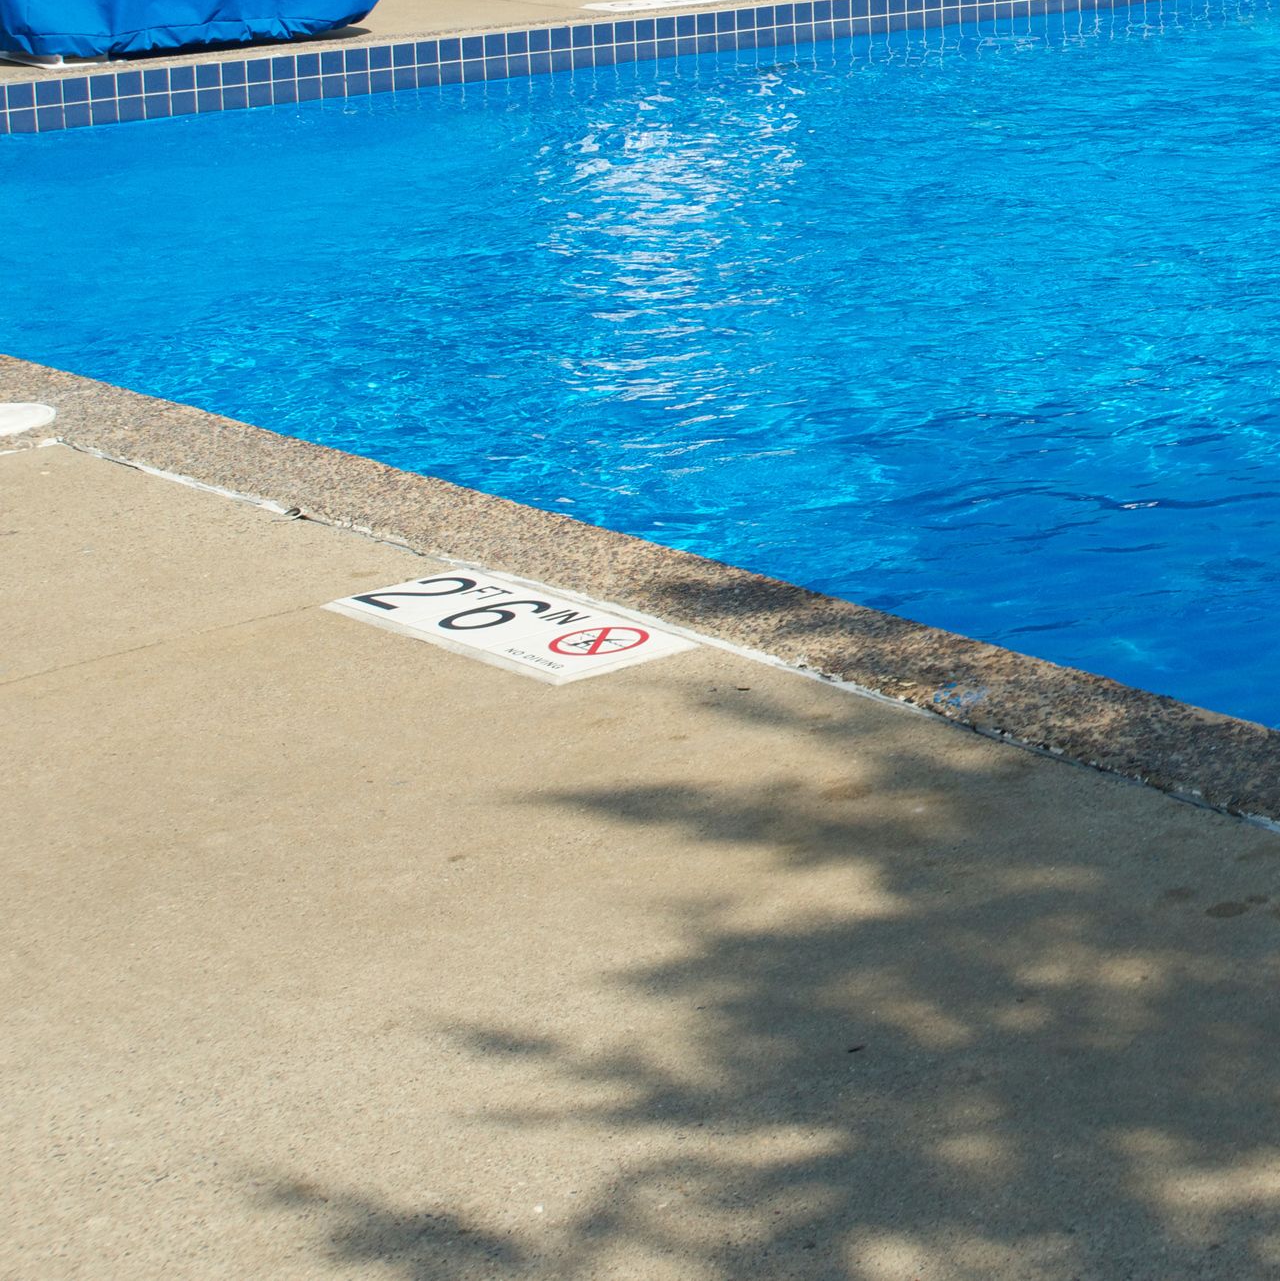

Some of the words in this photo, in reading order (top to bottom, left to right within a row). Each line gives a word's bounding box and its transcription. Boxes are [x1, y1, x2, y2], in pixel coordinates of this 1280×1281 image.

[351, 576, 477, 610] 2
[461, 585, 514, 600] FT
[438, 599, 552, 630] 6
[538, 609, 592, 626] IN
